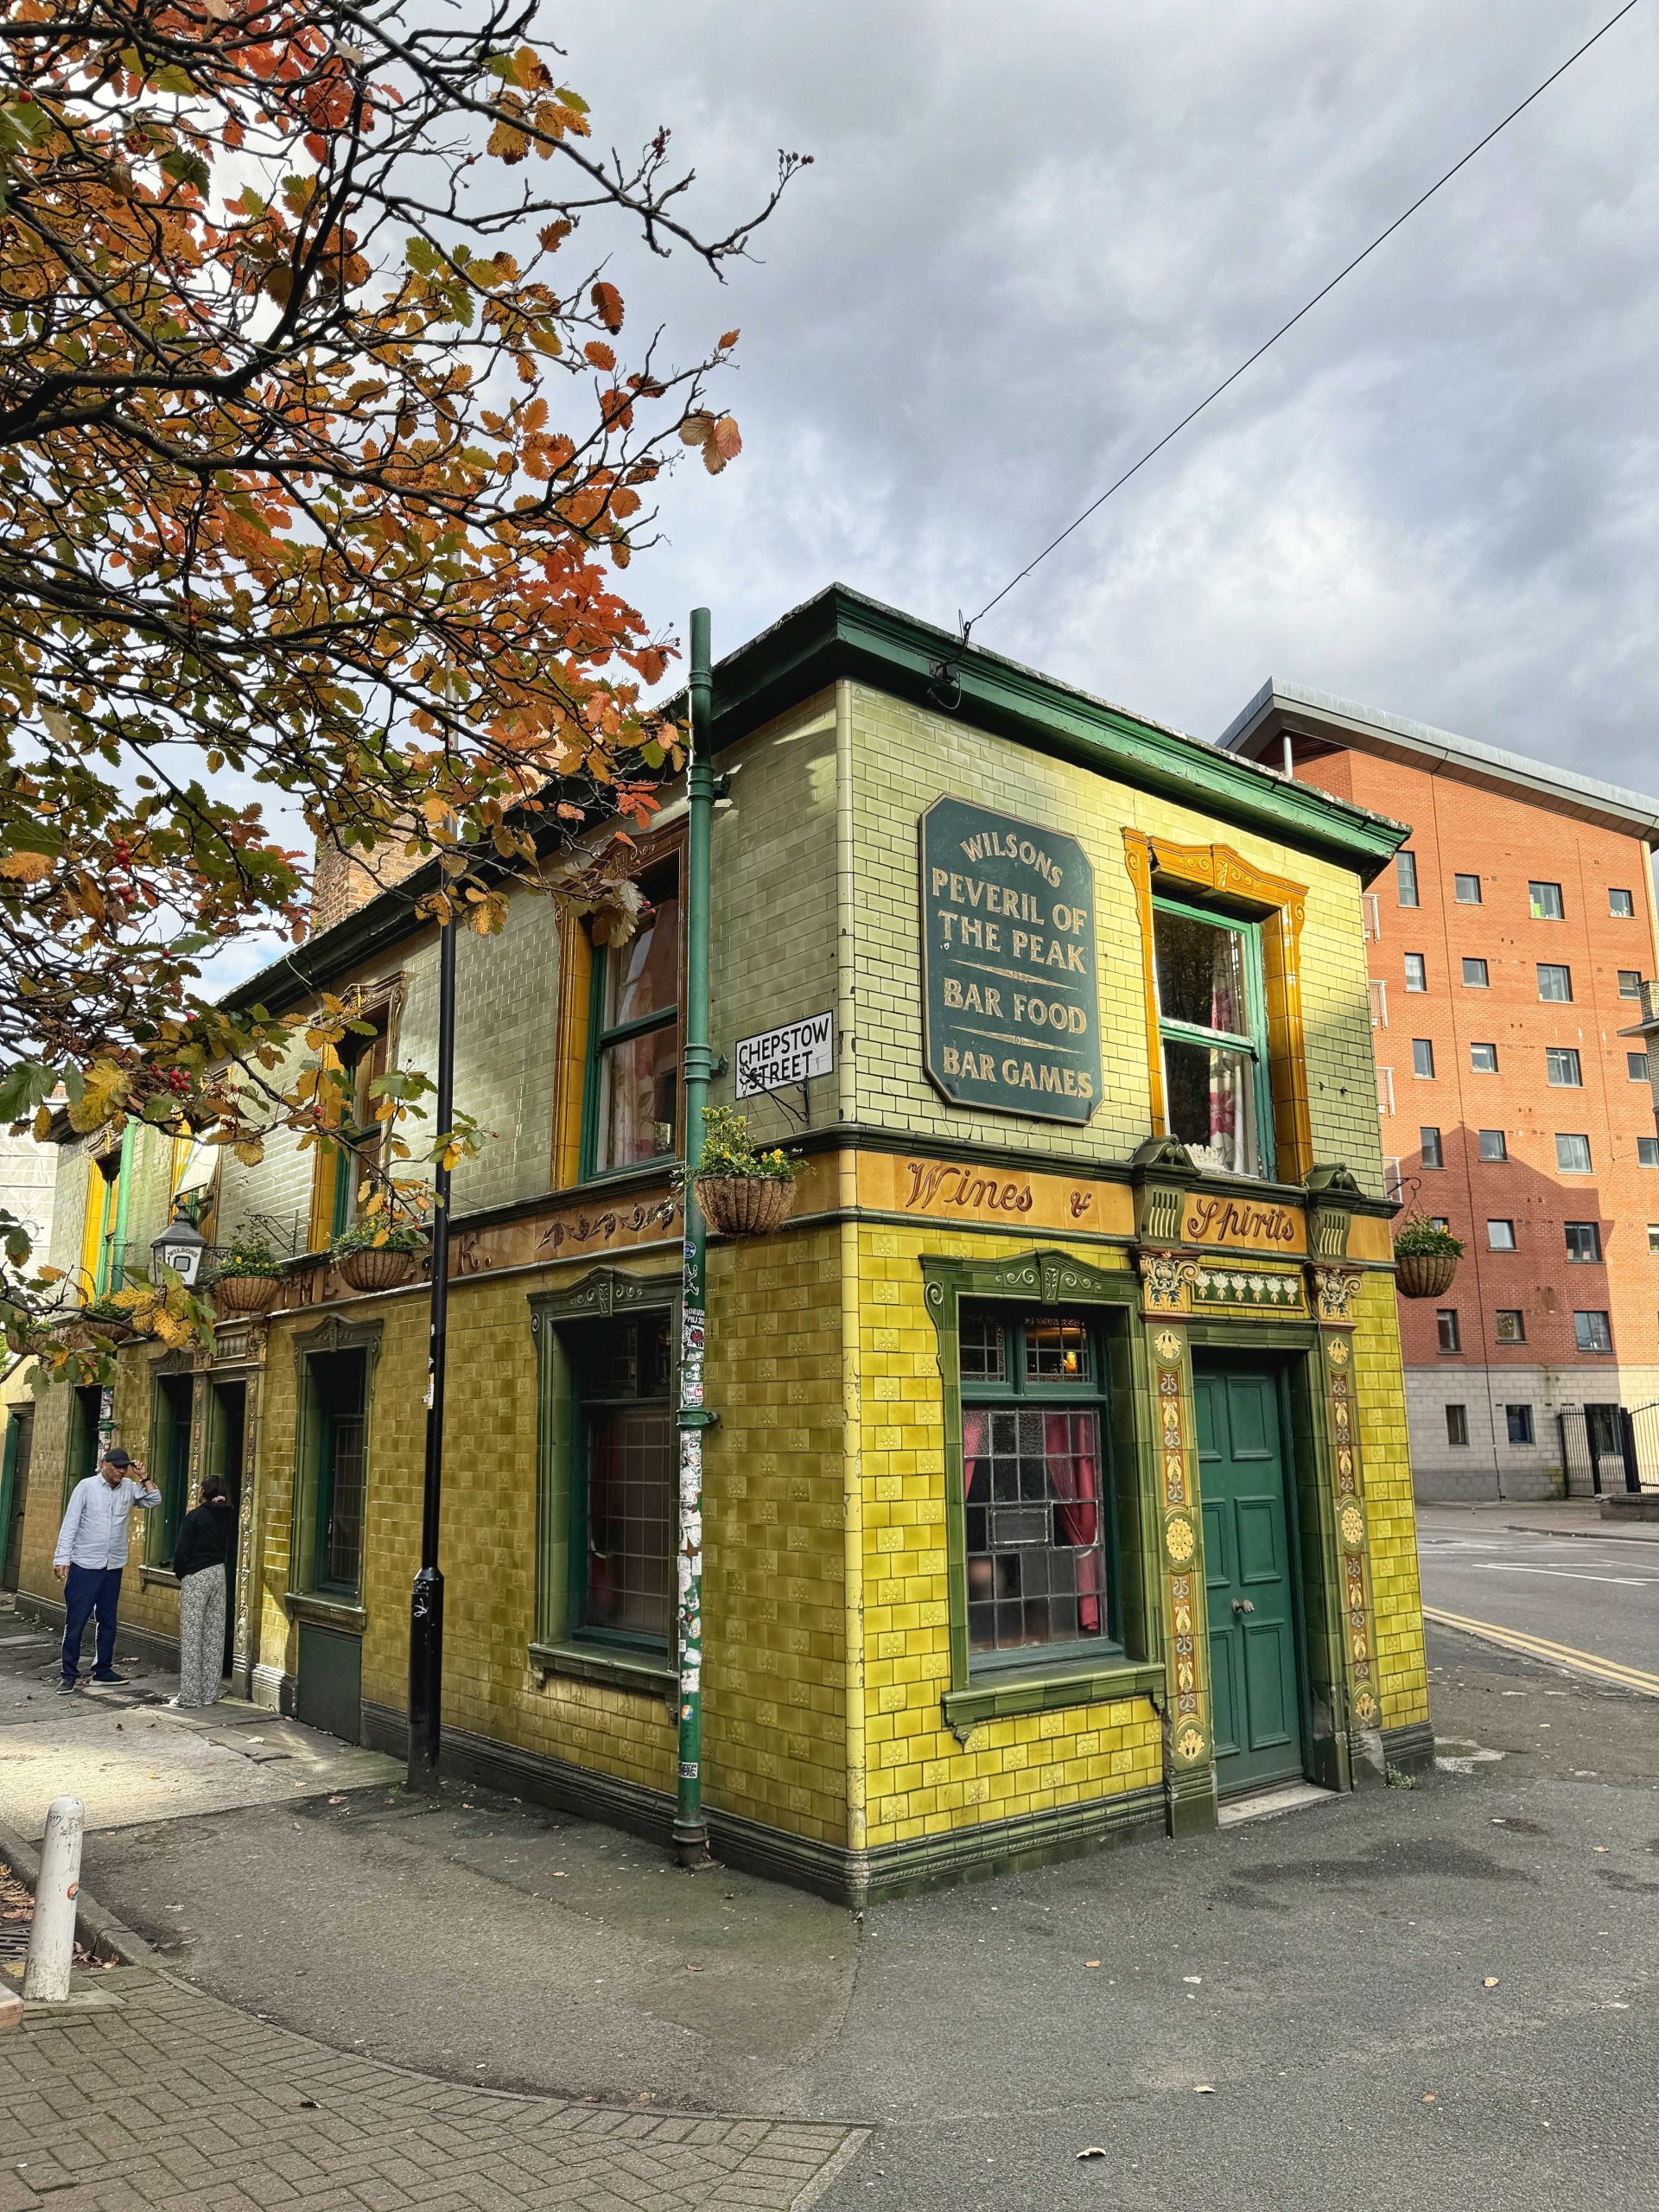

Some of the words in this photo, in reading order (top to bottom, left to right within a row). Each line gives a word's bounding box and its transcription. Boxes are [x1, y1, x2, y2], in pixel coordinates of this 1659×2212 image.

[959, 831, 1064, 889] WILSONS
[931, 867, 1045, 925] PEVERIL
[1052, 903, 1088, 936] OF
[938, 910, 1001, 953] THE
[1012, 928, 1087, 975] PEAK
[944, 977, 1003, 1018] BAR
[1013, 992, 1087, 1035] FOOD
[739, 1017, 830, 1066] CHEPSTOW
[748, 1050, 813, 1090] STREET
[943, 1044, 996, 1083] BAR
[1001, 1058, 1094, 1099] GAMES
[906, 1161, 1033, 1212] Wines
[1071, 1190, 1092, 1217] &
[1187, 1198, 1294, 1242] Spirits
[168, 1247, 199, 1258] WILSONS
